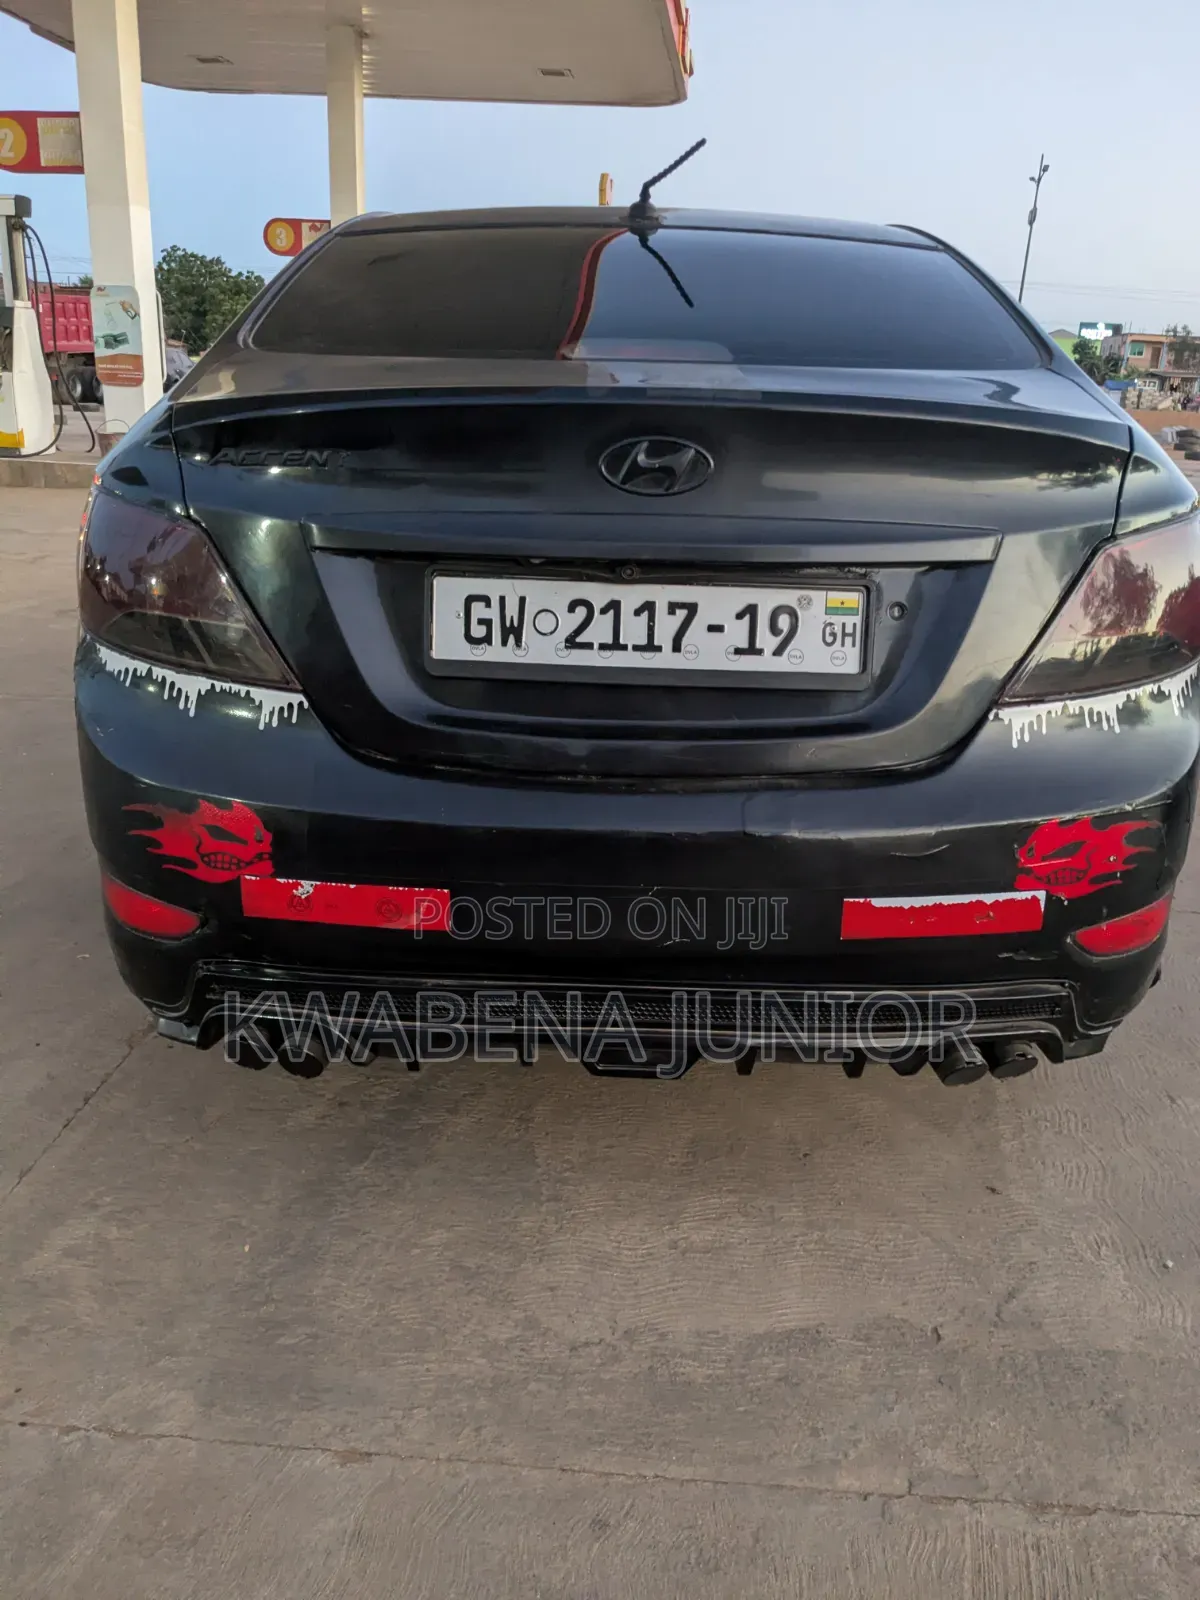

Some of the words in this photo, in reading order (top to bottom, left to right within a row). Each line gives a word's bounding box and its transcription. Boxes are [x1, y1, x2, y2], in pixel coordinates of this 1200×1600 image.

[0, 128, 15, 158] 2
[275, 228, 287, 246] 3
[463, 594, 528, 648] GW
[565, 598, 800, 657] 2117-19
[821, 621, 857, 648] GH
